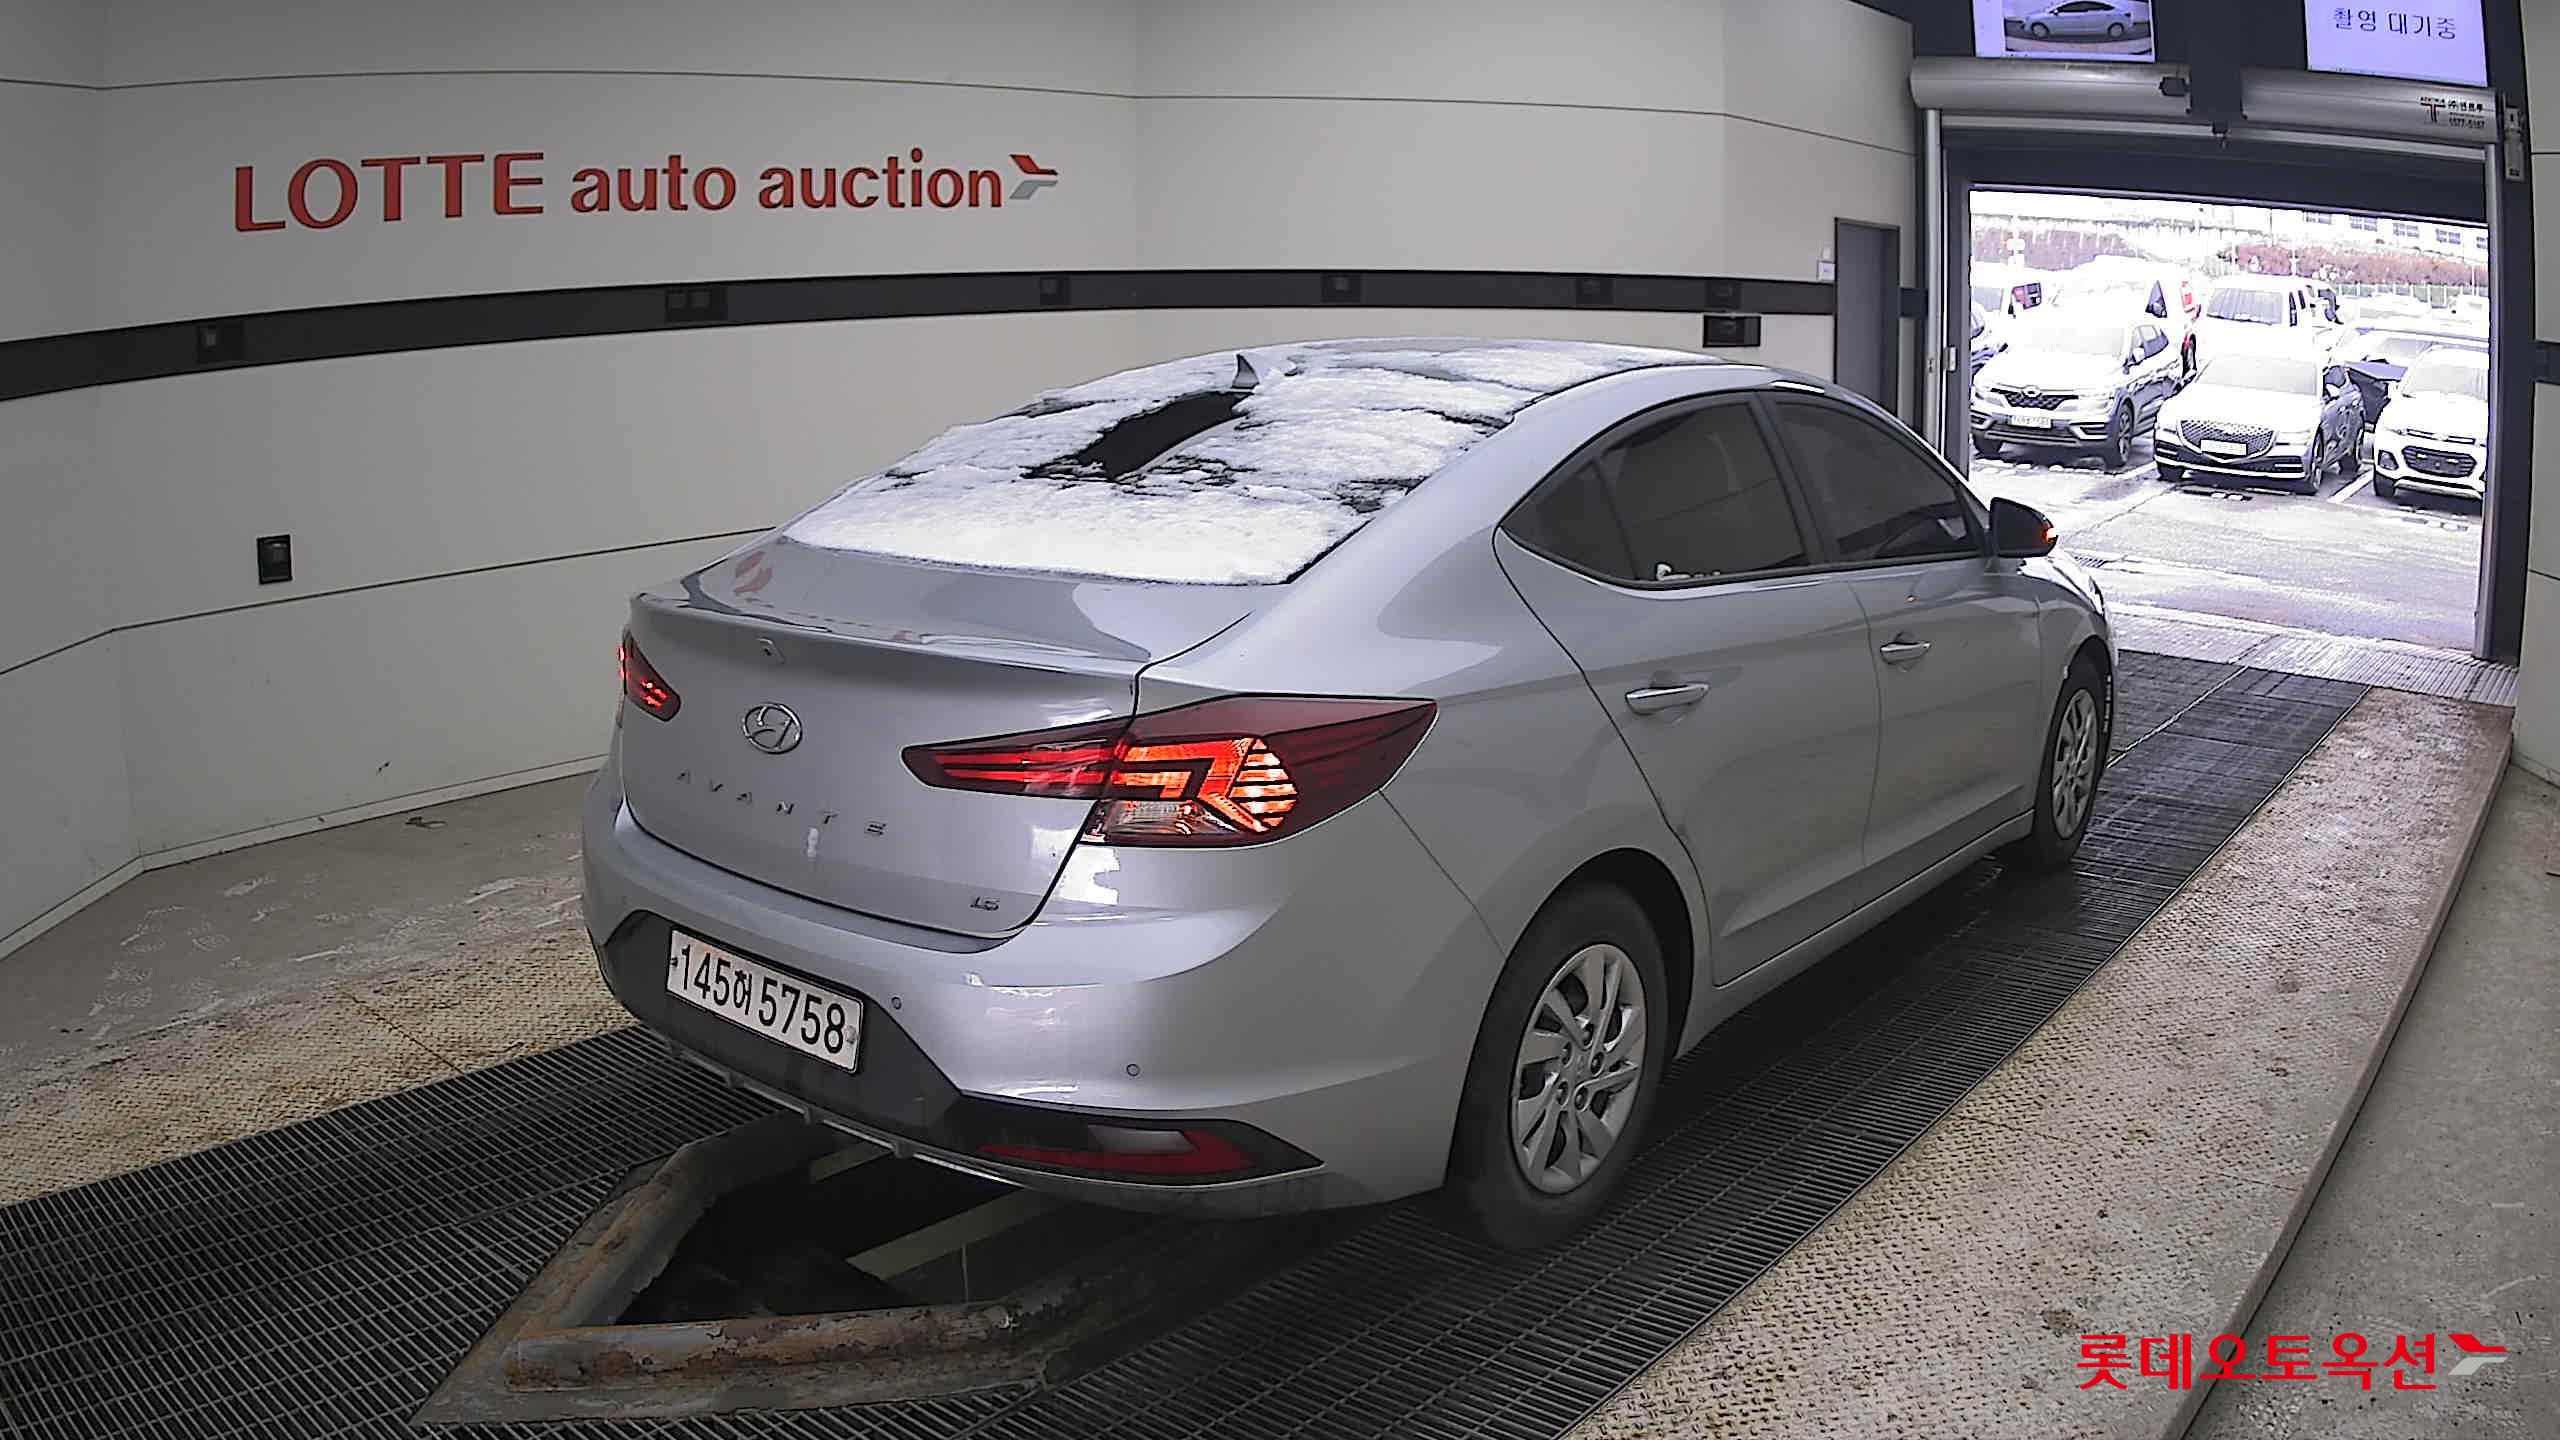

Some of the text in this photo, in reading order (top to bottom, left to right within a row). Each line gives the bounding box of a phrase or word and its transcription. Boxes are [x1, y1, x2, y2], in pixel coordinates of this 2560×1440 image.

[2333, 8, 2456, 40] 촬영 대기중
[235, 147, 1003, 232] LOTTE auto auction
[677, 768, 888, 836] AVANTE
